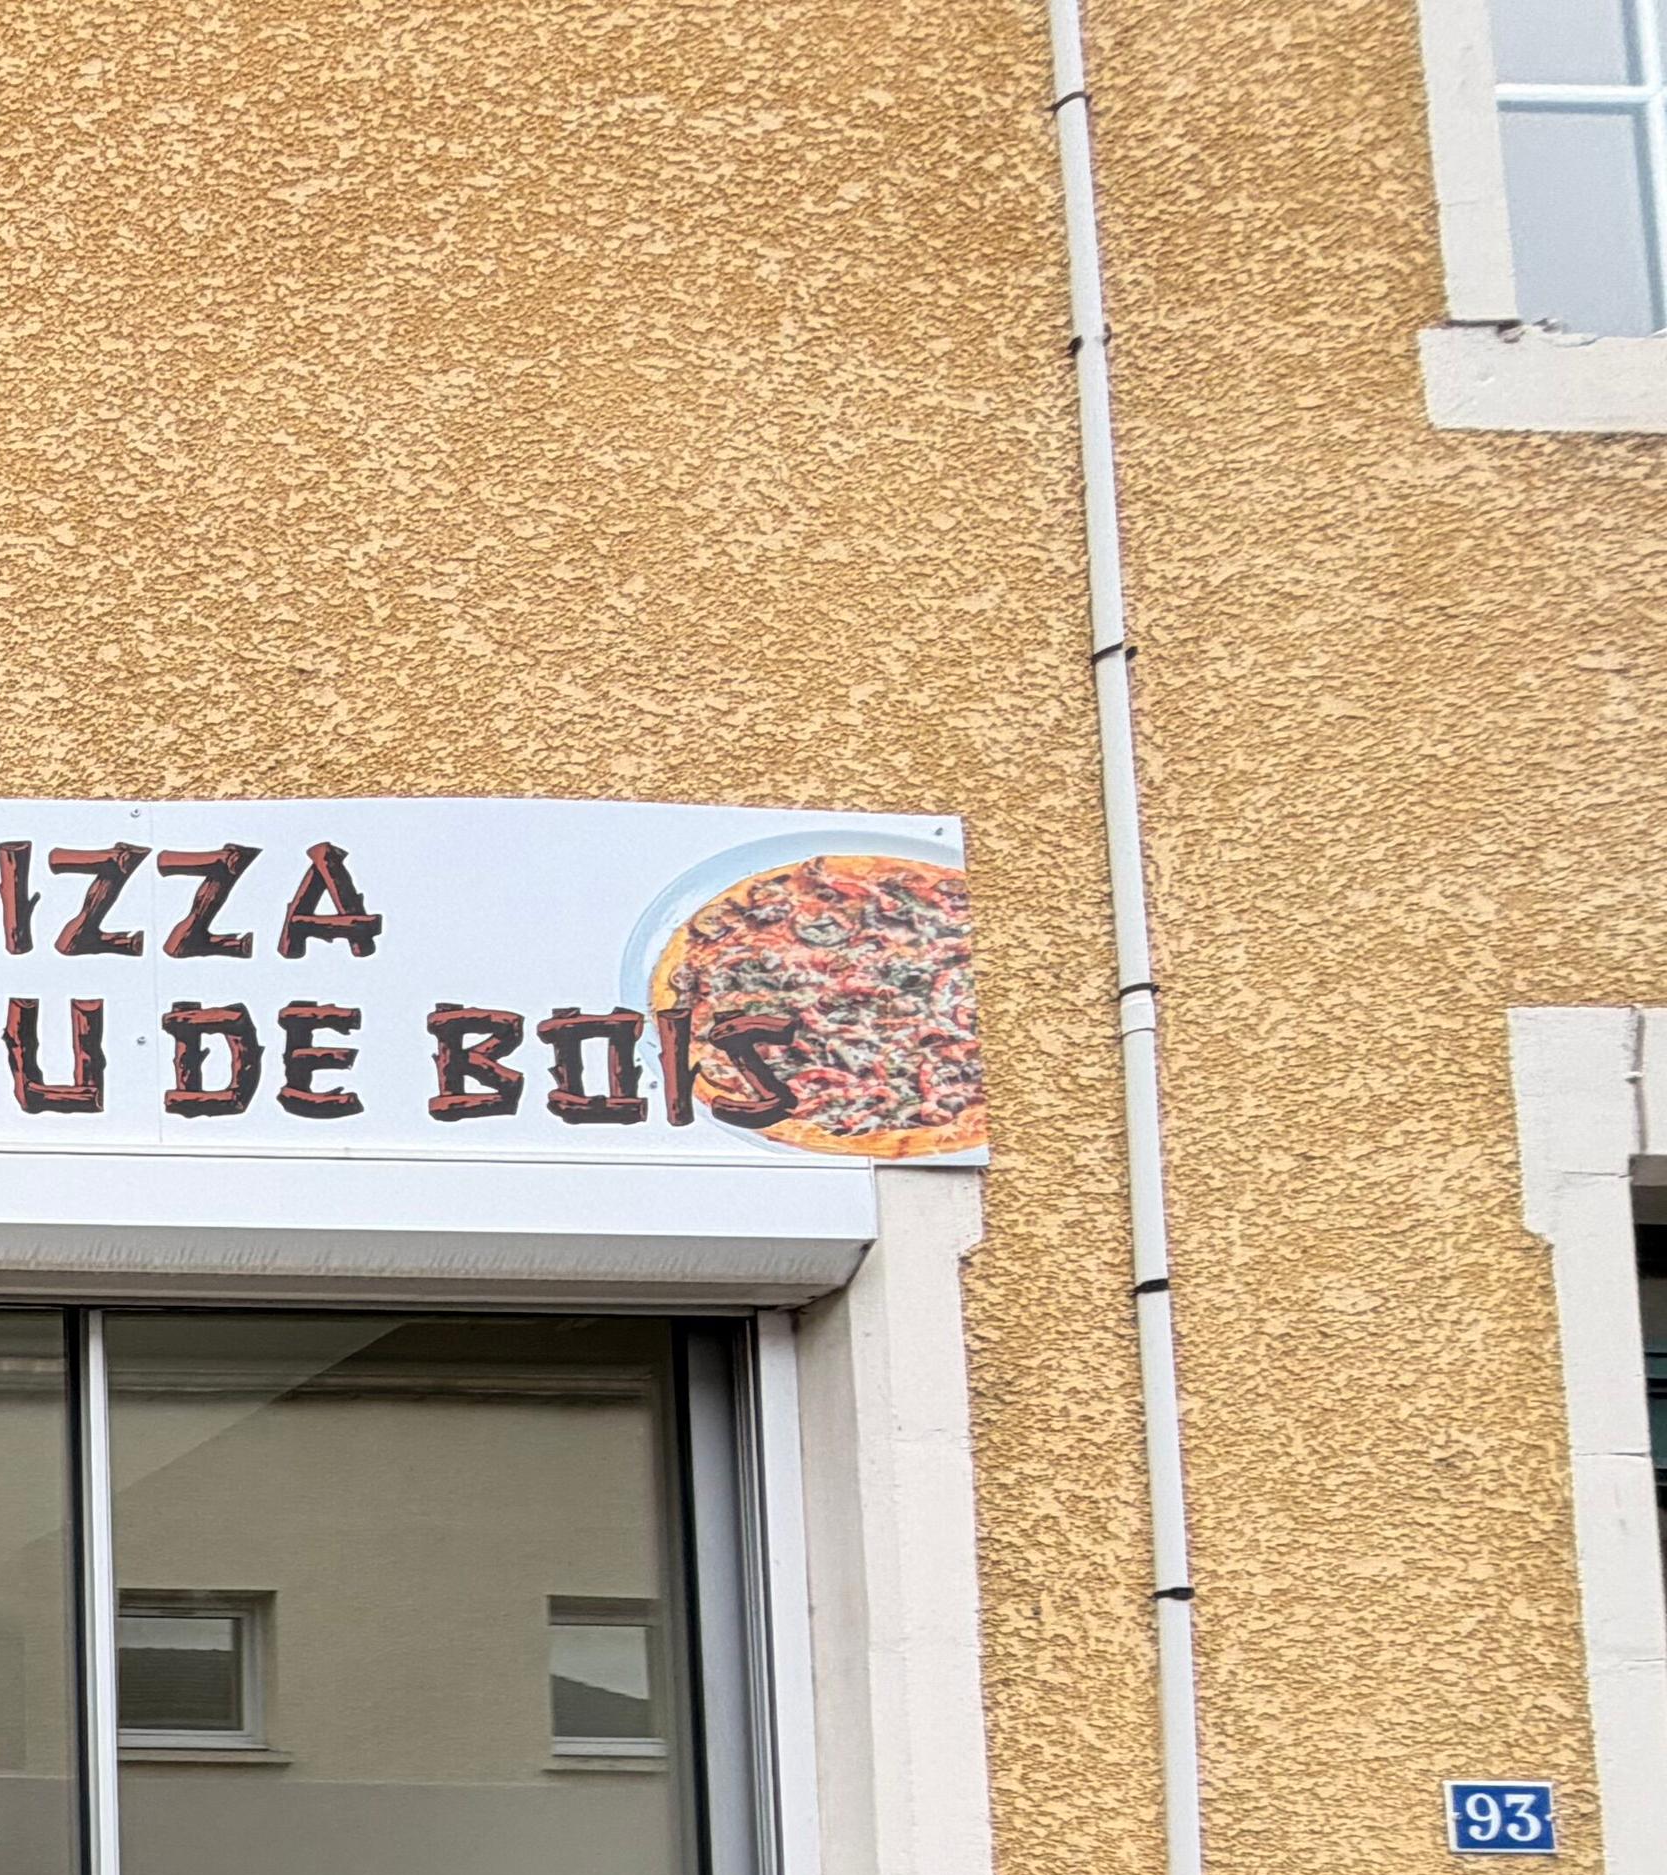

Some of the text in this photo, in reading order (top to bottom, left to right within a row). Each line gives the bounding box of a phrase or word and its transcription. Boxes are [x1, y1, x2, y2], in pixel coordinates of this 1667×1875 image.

[161, 1000, 365, 1119] DE
[426, 1002, 803, 1129] BOIS
[1465, 1792, 1543, 1842] 93
